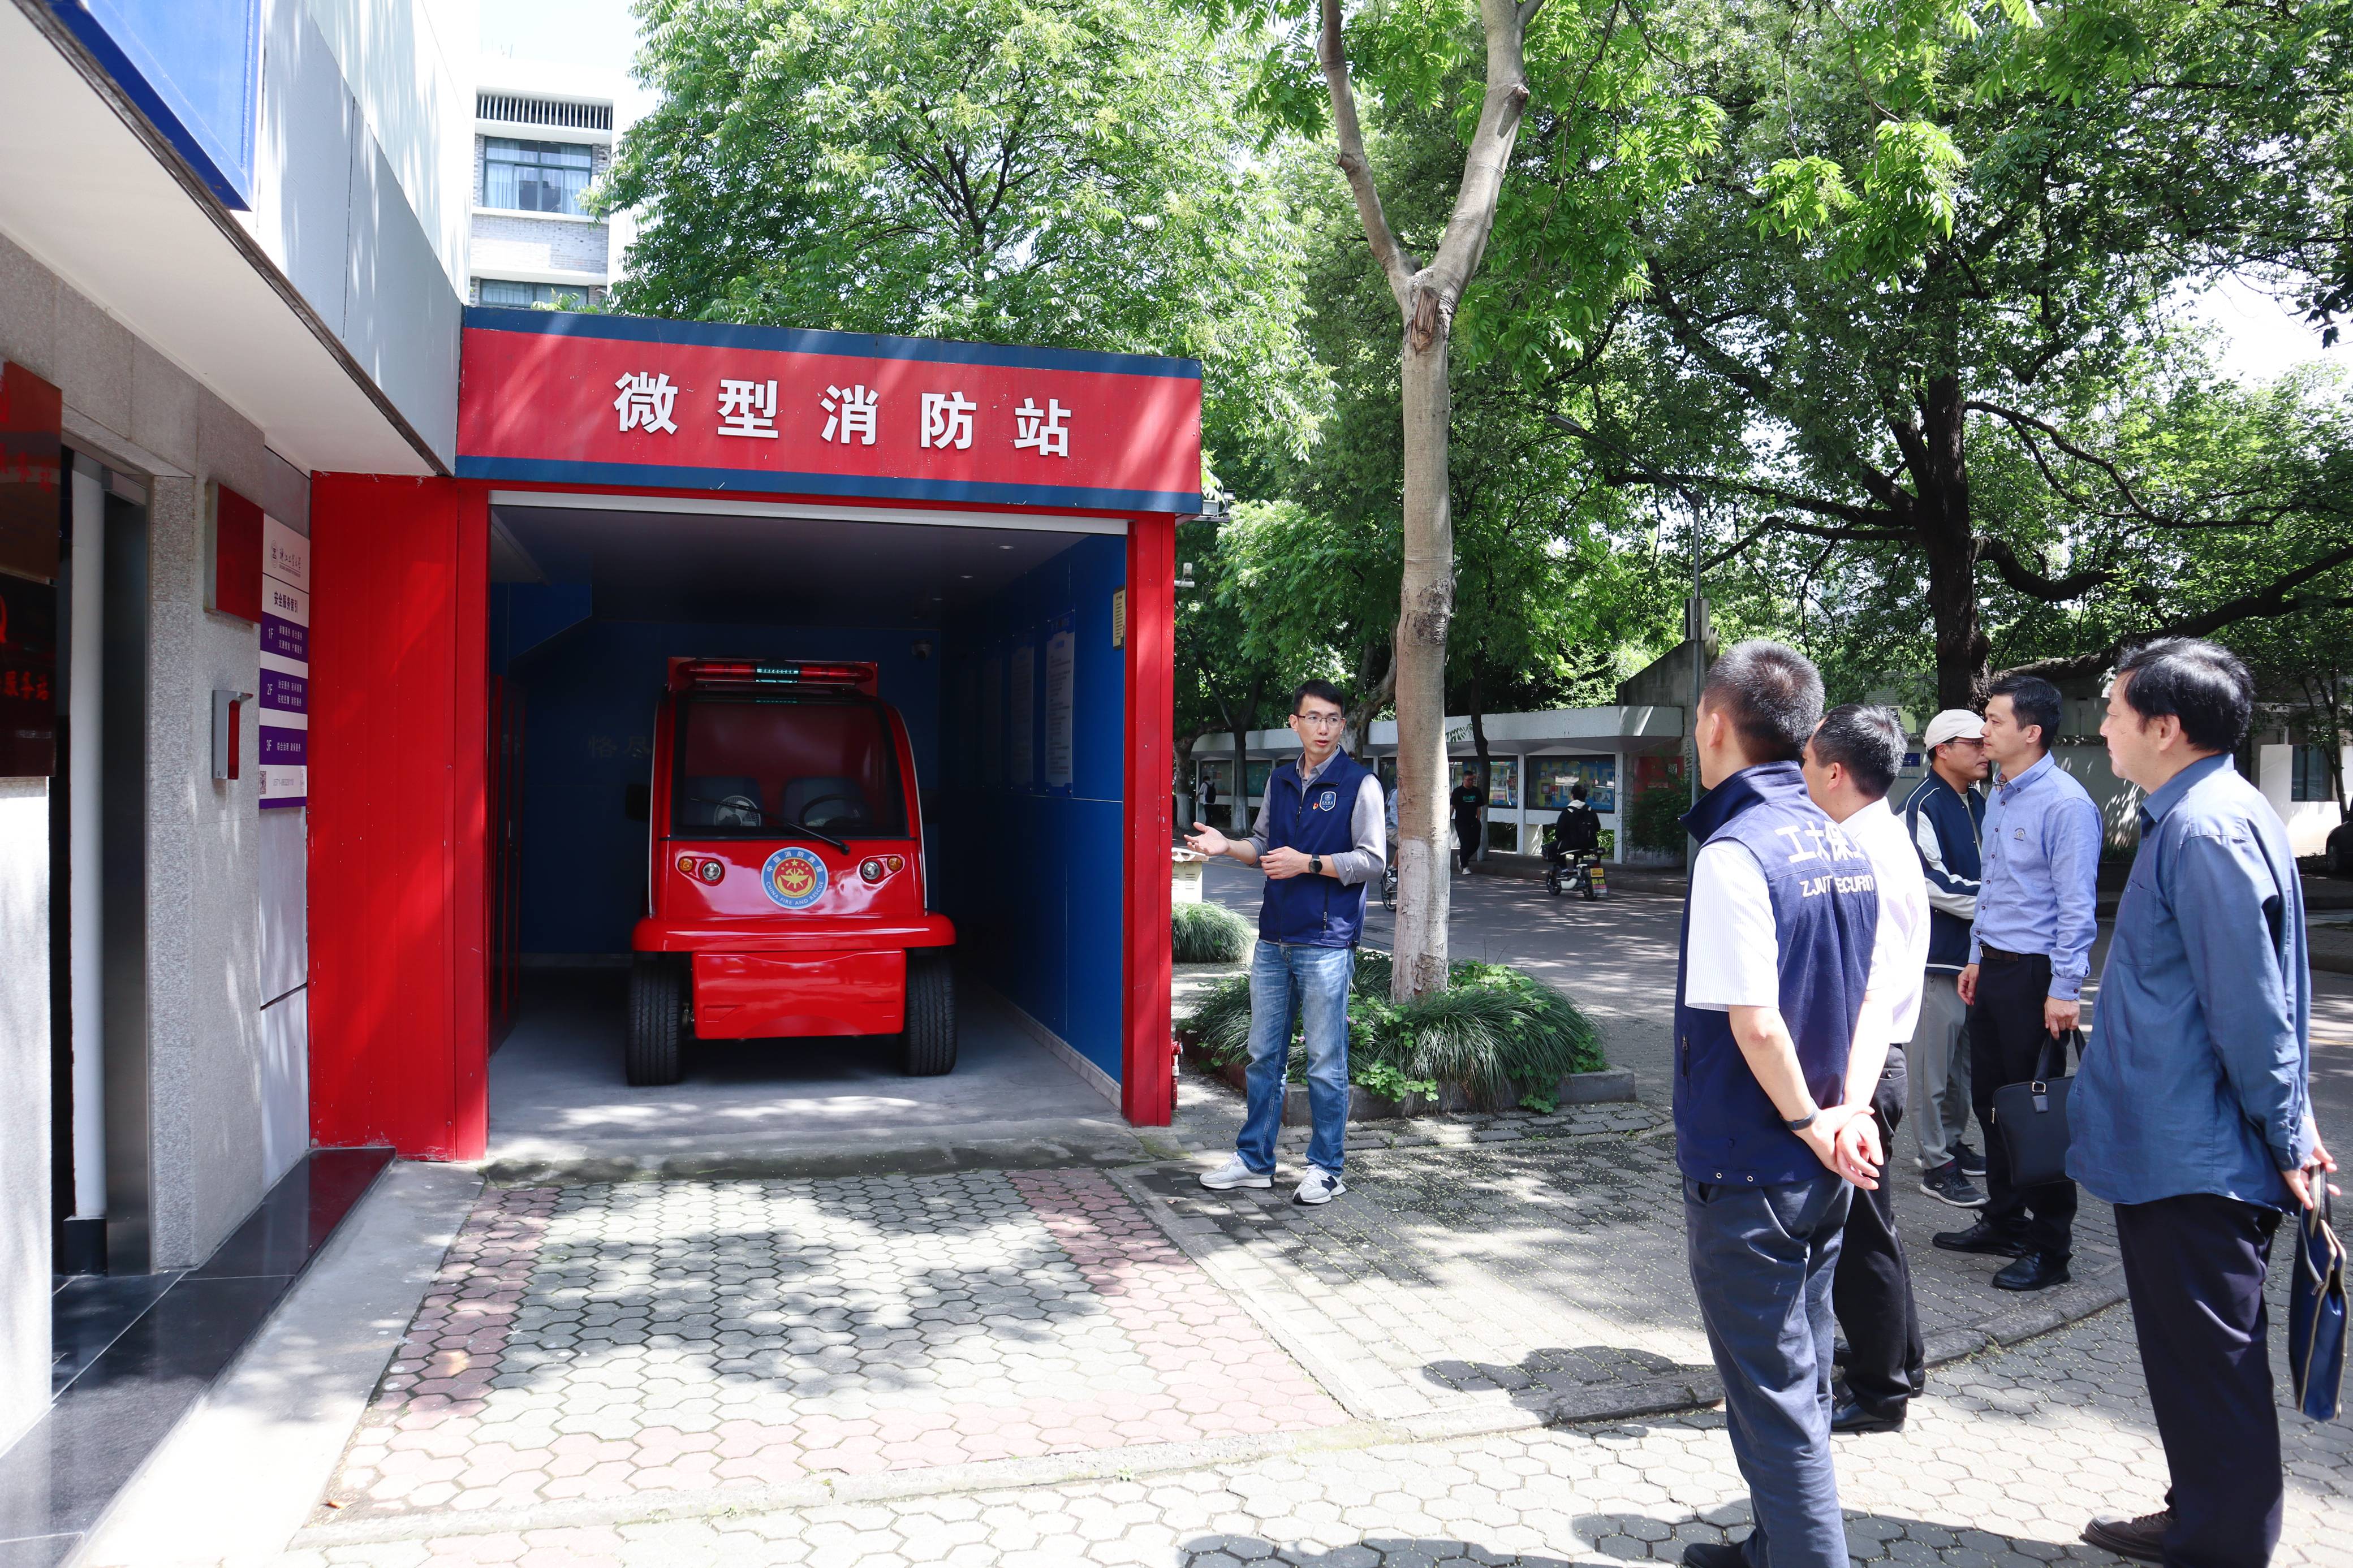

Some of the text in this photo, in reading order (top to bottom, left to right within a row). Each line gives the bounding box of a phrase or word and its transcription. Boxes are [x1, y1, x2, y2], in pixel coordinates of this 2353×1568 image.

[613, 371, 1072, 457] 微型消防站
[274, 591, 298, 614] 安全服务索引
[269, 628, 274, 640] 1F
[267, 683, 273, 696] 2F
[266, 739, 272, 751] 3F
[766, 851, 824, 872] 中国消防救援
[766, 881, 779, 899] CHINA
[809, 881, 824, 900] RESCUE
